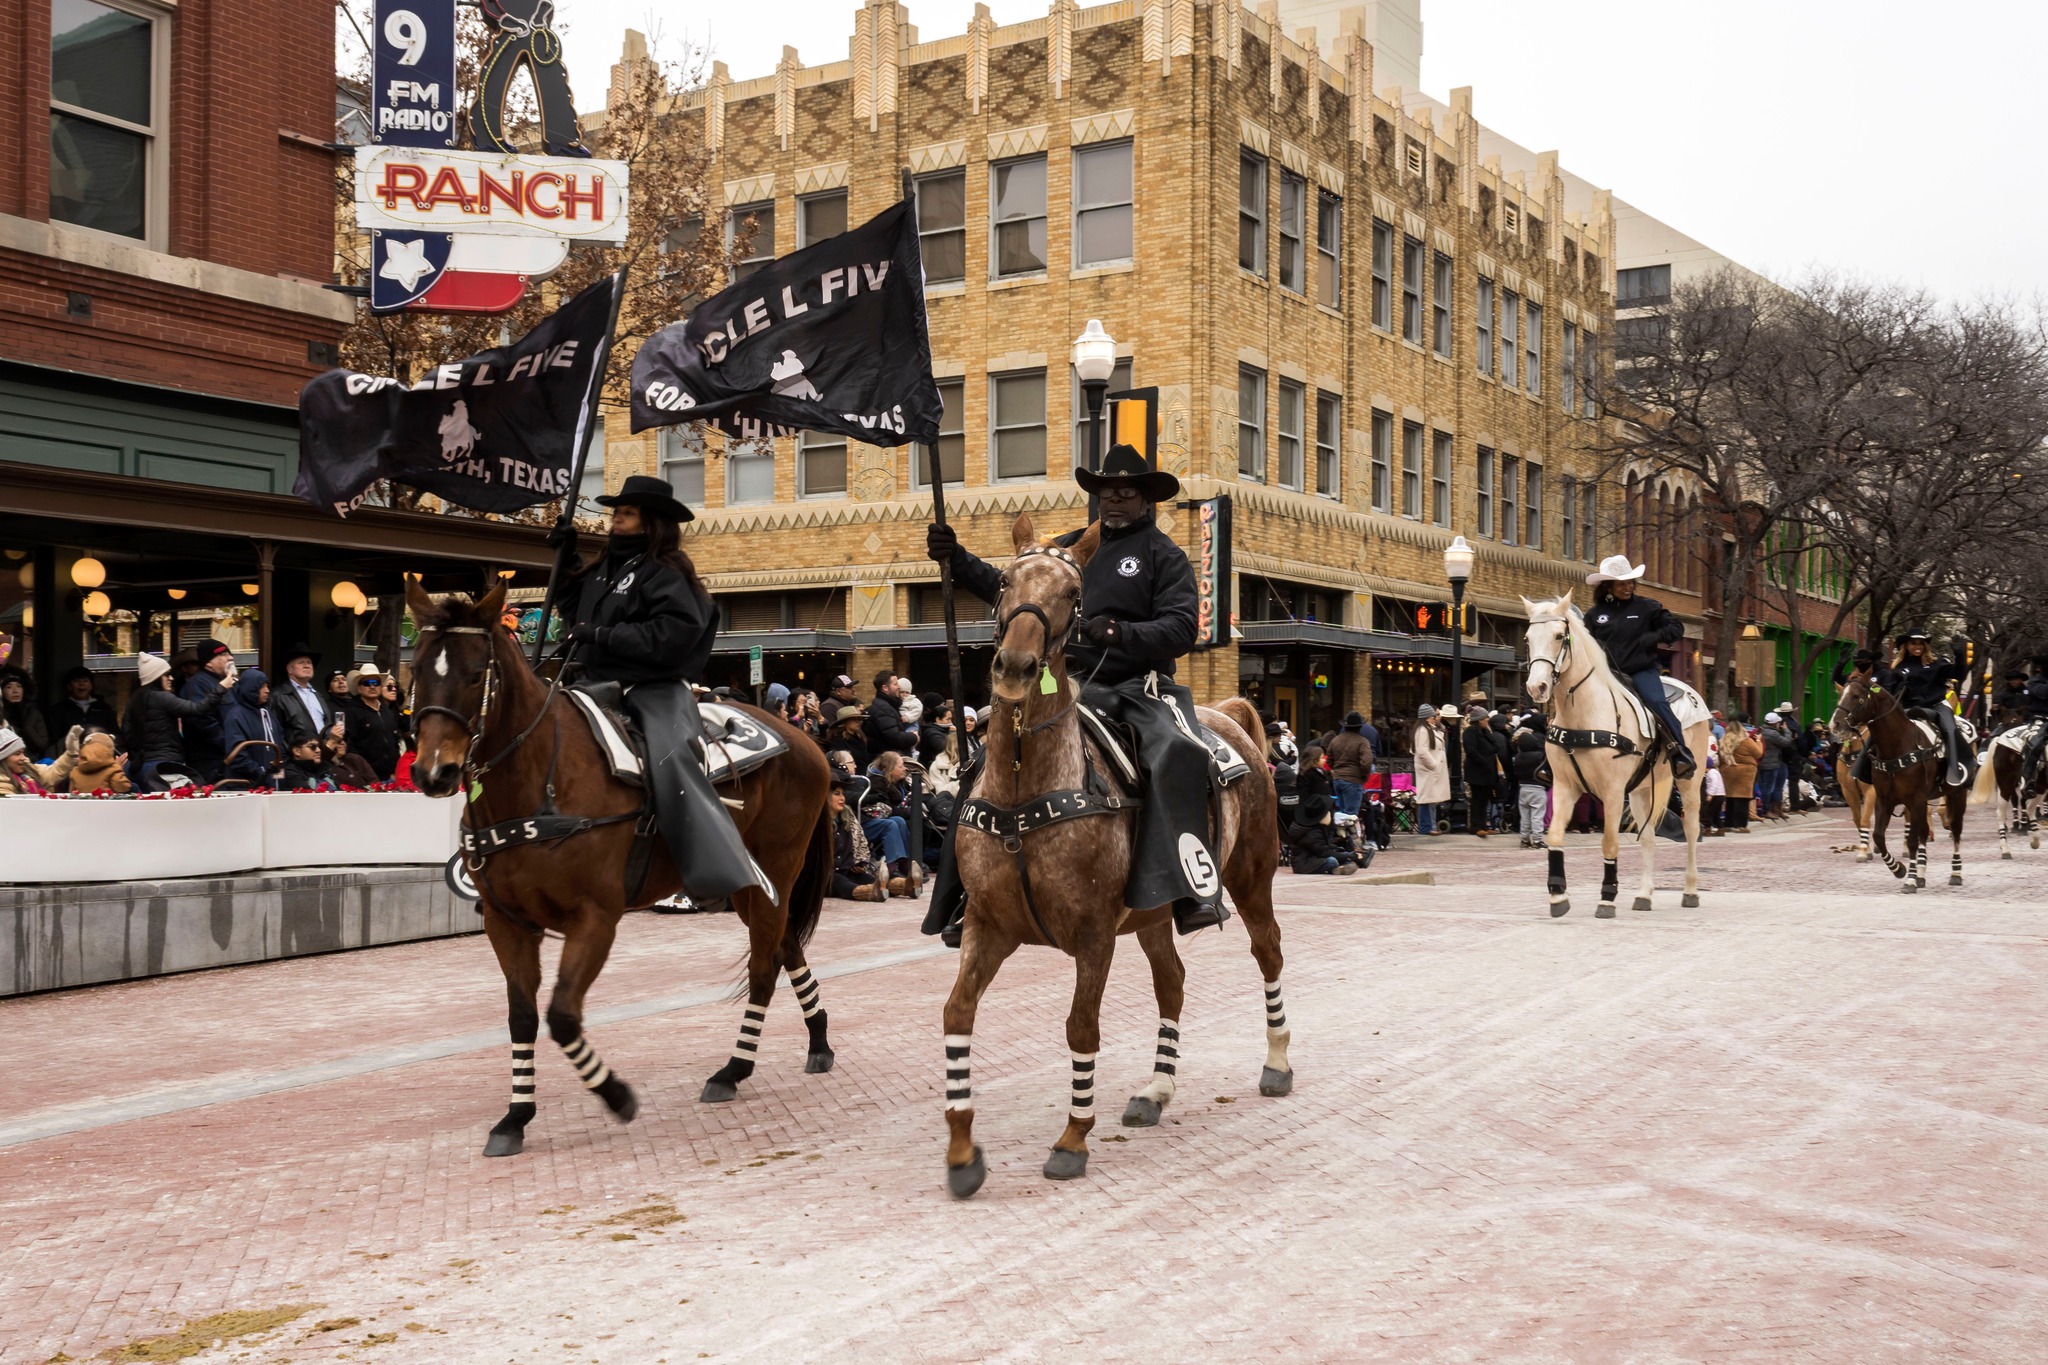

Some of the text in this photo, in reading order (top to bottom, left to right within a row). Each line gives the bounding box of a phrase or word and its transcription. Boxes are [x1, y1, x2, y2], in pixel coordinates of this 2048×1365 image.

[384, 9, 428, 66] 9
[387, 80, 440, 106] FM
[379, 106, 449, 131] RADIO
[376, 163, 604, 222] RANCH
[781, 285, 808, 319] L
[821, 260, 893, 305] FIV
[472, 363, 495, 386] L
[506, 340, 579, 382] FIVE
[499, 456, 570, 495] TEXAS
[1590, 731, 1599, 745] L
[1609, 733, 1618, 747] 5
[1046, 801, 1061, 819] L
[1073, 793, 1086, 809] 5
[489, 828, 507, 846] L
[523, 820, 539, 840] 5
